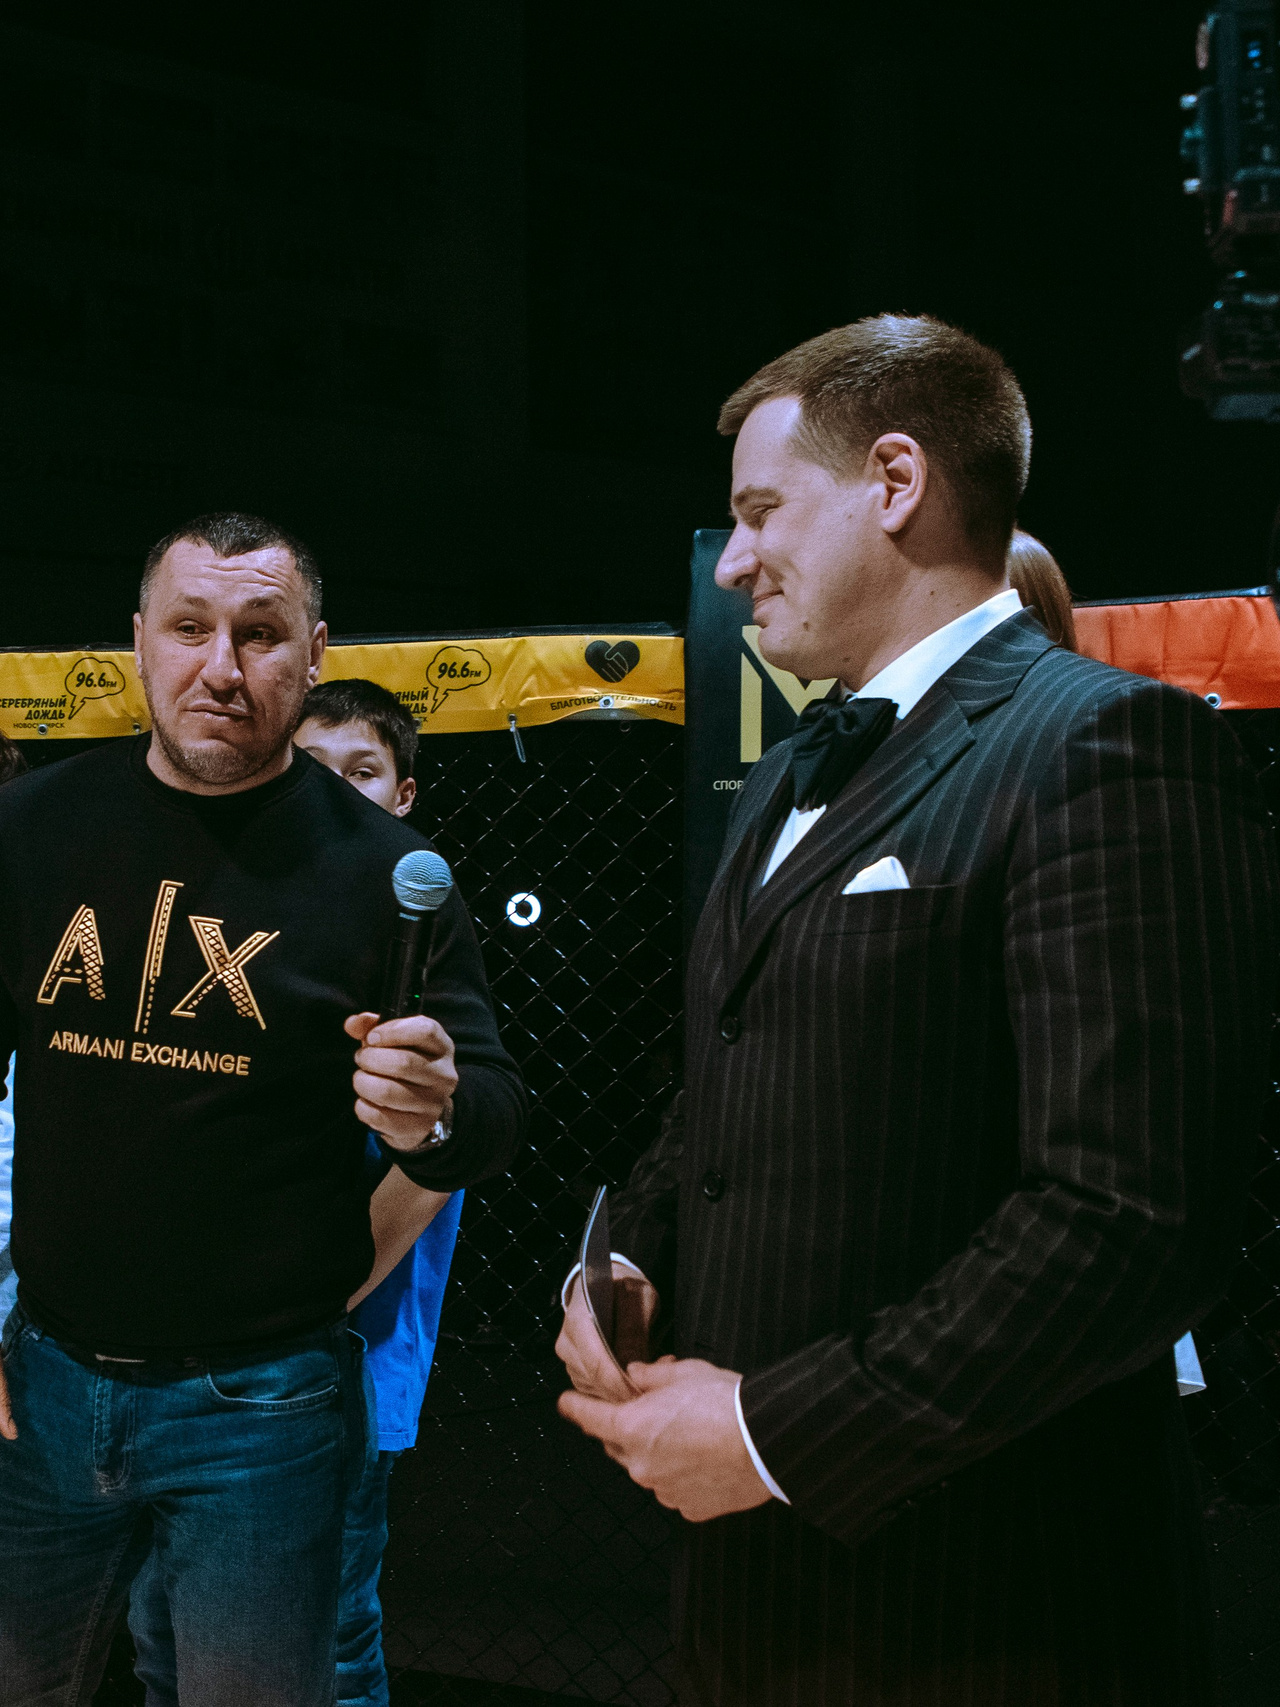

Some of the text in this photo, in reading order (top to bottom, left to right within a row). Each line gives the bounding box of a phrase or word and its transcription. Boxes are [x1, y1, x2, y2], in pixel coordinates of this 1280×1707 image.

[25, 709, 65, 720] ДОЖДЬ
[713, 780, 744, 791] СПОР
[48, 1030, 252, 1077] ARMANI EXCHANGE
